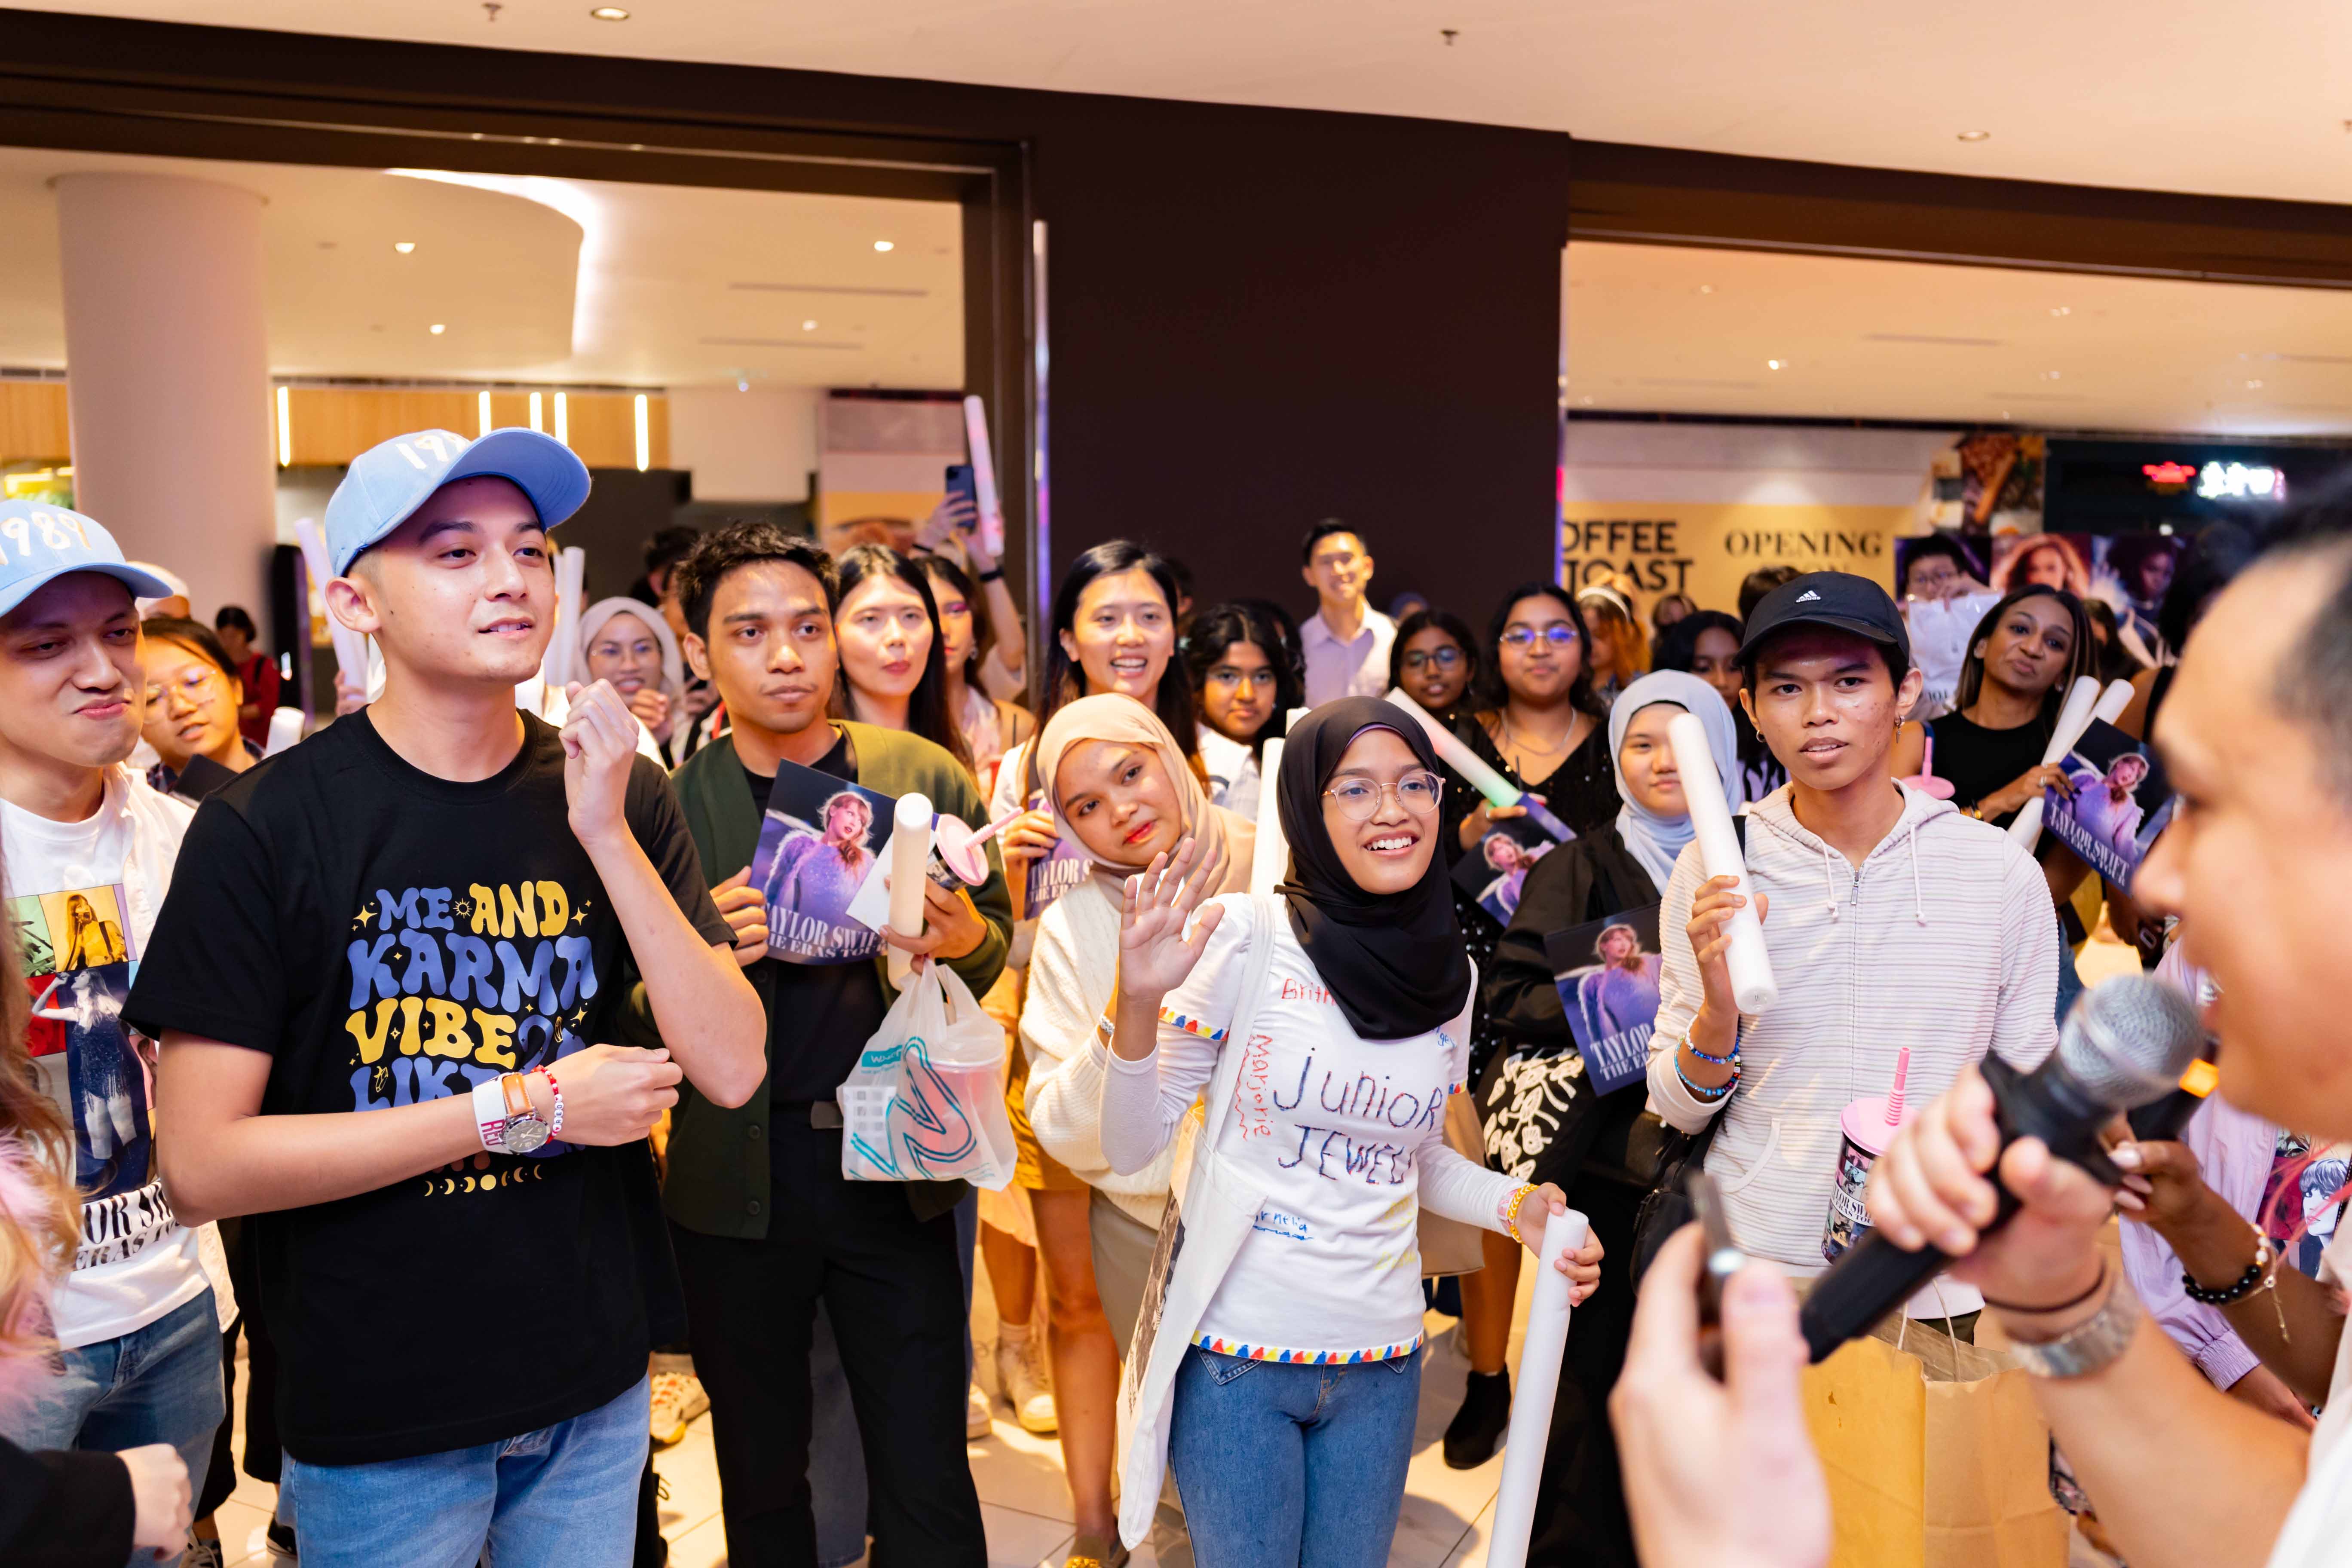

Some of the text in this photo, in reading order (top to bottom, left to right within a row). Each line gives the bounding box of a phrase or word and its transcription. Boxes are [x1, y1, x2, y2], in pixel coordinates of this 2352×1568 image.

[1724, 530, 1882, 557] OPENING
[2051, 802, 2092, 850] TAYLOR
[376, 880, 570, 938] ME AND
[766, 903, 829, 946] AYLOR
[347, 928, 598, 1016] KARMA
[345, 996, 516, 1070] VIBE
[1246, 1034, 1274, 1137] Marjorie
